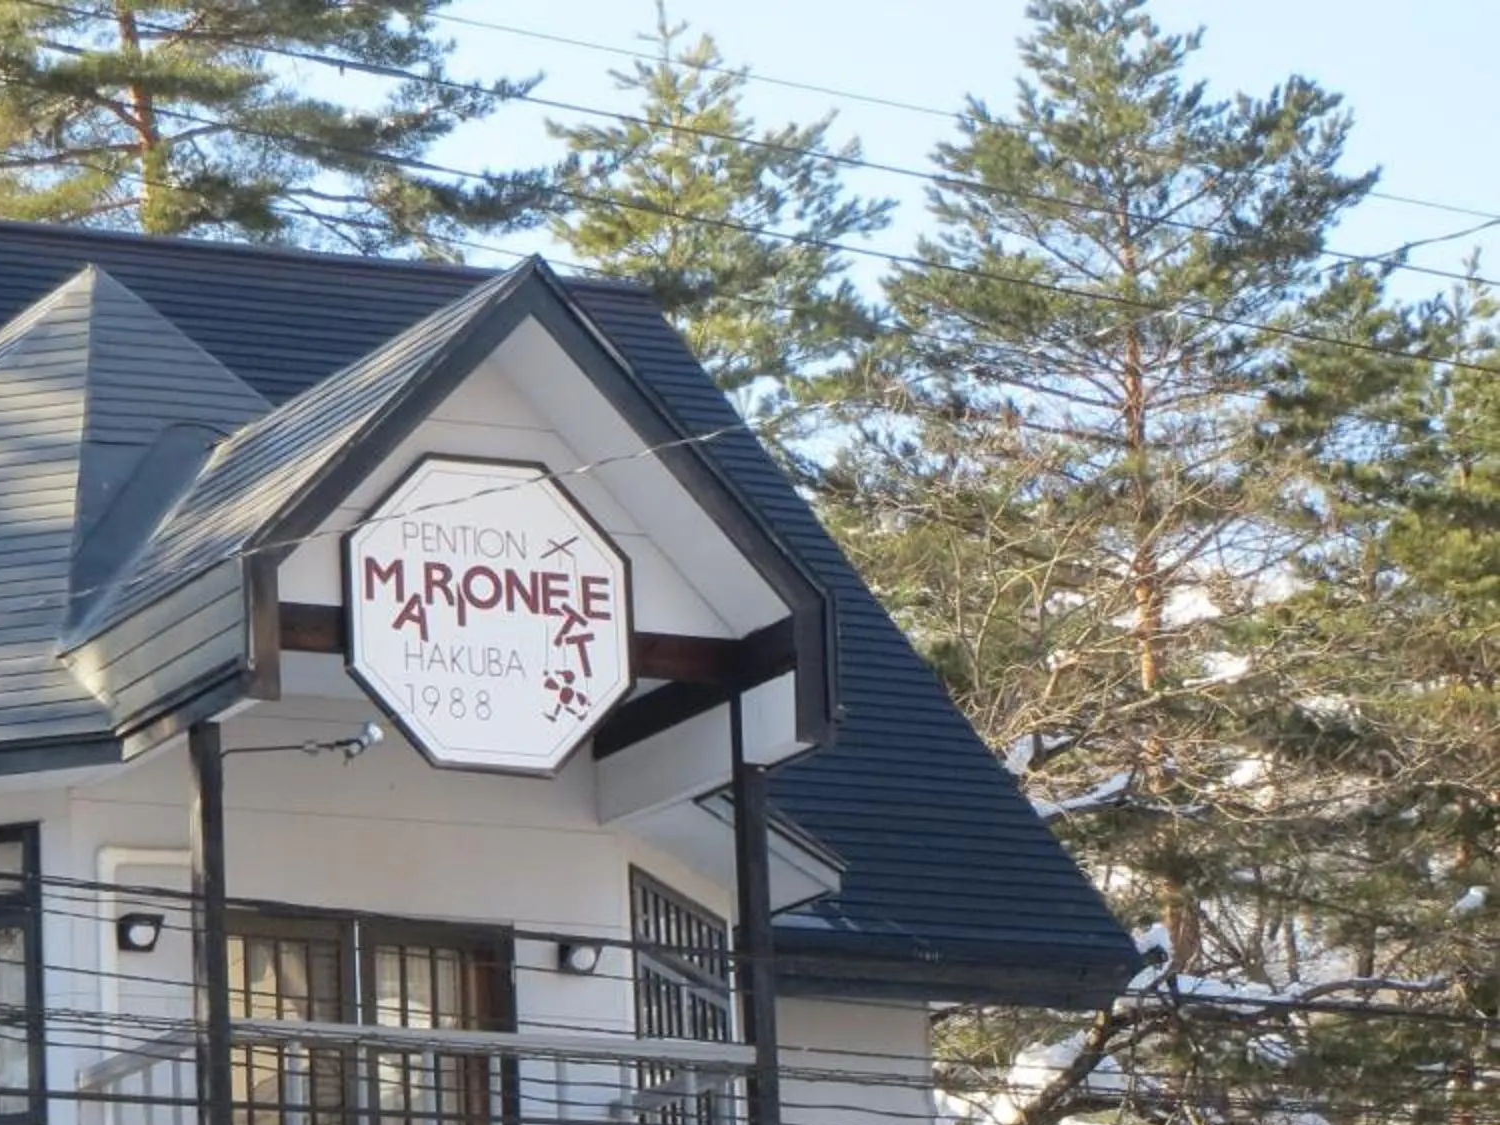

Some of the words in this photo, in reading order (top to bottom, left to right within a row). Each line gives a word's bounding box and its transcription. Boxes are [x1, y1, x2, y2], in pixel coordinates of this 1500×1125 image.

[401, 521, 527, 560] PENTION
[404, 641, 527, 678] HAKUBA
[404, 683, 494, 721] 1988
